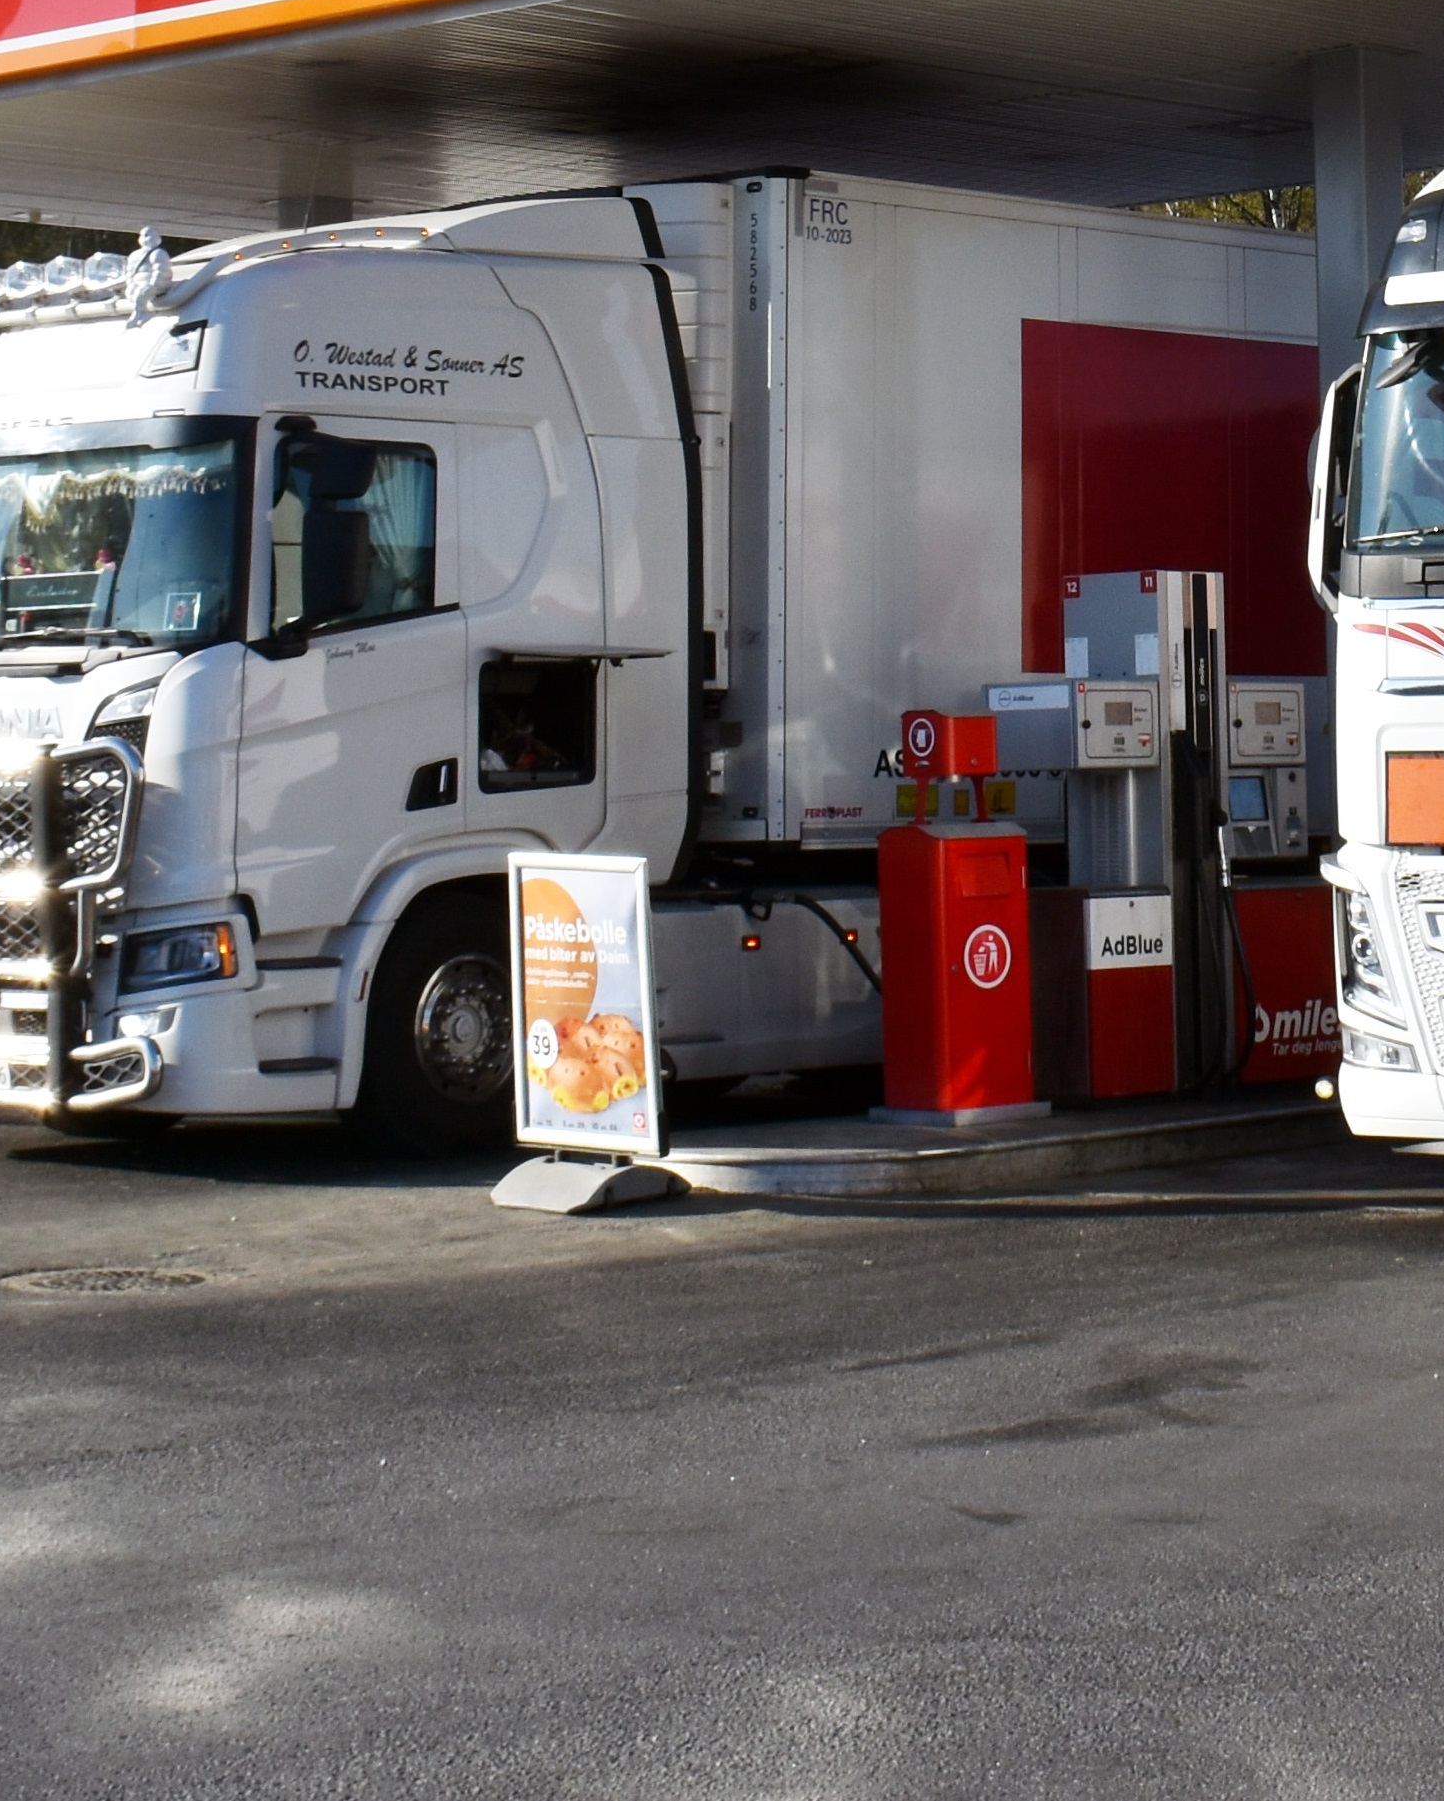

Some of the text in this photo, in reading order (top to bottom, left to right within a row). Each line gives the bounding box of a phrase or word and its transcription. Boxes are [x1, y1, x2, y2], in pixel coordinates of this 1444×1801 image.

[809, 198, 849, 225] FRC
[806, 225, 852, 245] 10-2023
[748, 213, 758, 312] 582568
[293, 339, 314, 363] O.
[325, 342, 397, 368] Westad
[403, 345, 418, 368] &
[489, 353, 525, 378] AS
[294, 371, 450, 397] TRANSPORT
[1066, 581, 1078, 593] 12
[1144, 576, 1153, 588] 11
[524, 912, 627, 945] Påskebolle
[524, 947, 630, 964] med biter av Daim
[1101, 933, 1164, 957] AdBlue
[1272, 1042, 1290, 1056] Tar
[1291, 1041, 1313, 1056] deg
